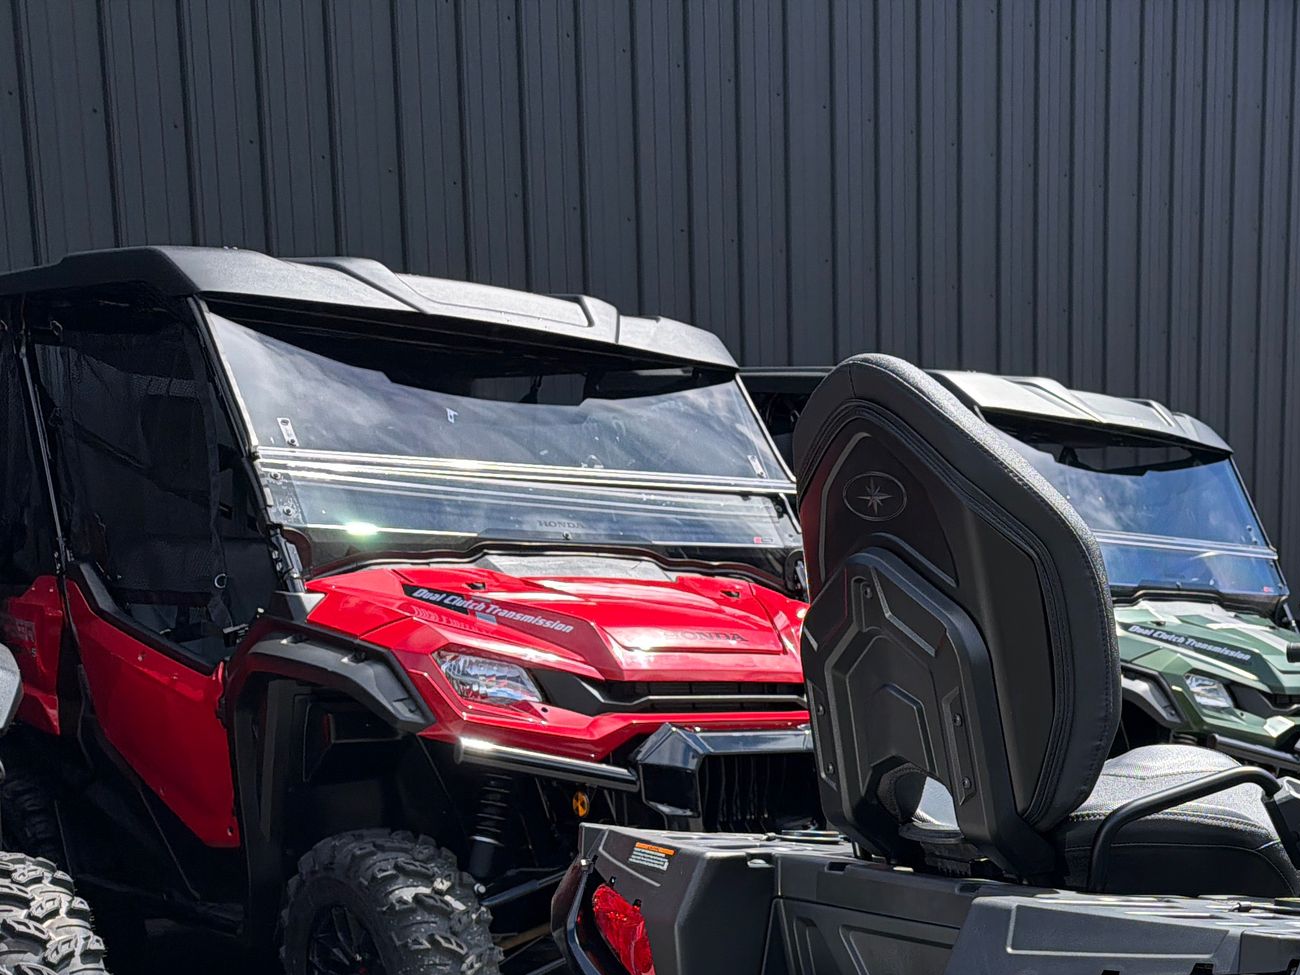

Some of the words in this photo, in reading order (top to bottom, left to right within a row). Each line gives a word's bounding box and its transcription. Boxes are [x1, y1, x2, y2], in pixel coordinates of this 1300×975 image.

[412, 588, 444, 602] Dual
[444, 594, 486, 612] Clutch
[485, 604, 575, 634] Transmission
[663, 630, 748, 642] HONDA
[1128, 624, 1155, 636] Dual
[1153, 630, 1186, 645] Clutch
[1185, 638, 1252, 661] Transmission
